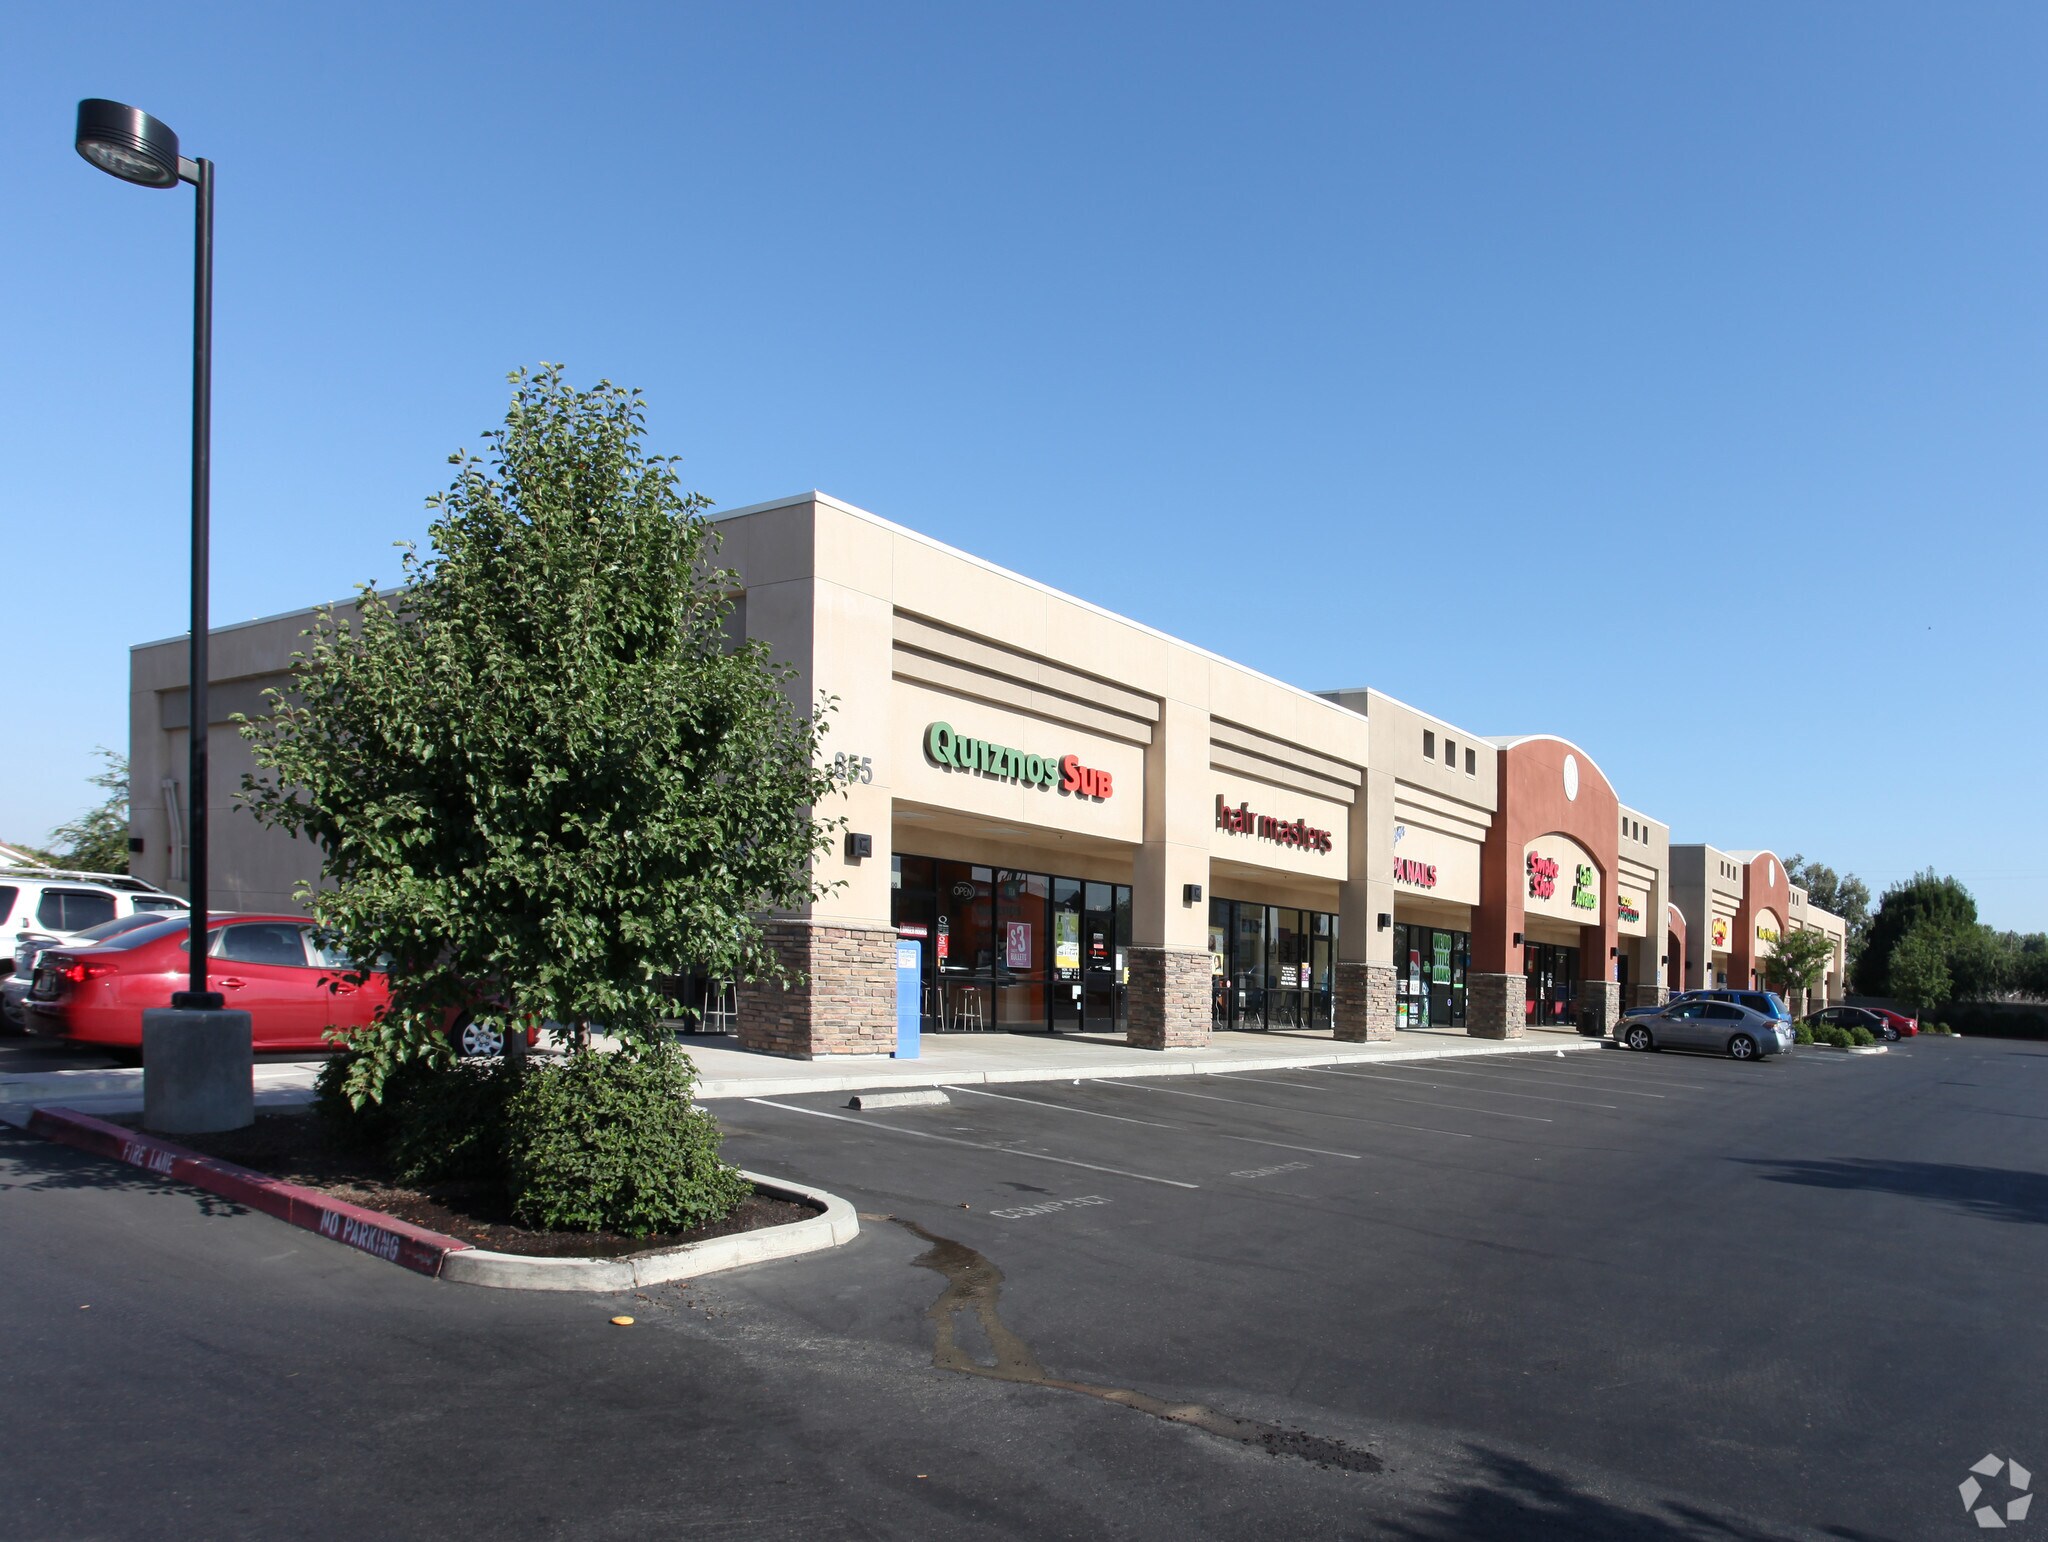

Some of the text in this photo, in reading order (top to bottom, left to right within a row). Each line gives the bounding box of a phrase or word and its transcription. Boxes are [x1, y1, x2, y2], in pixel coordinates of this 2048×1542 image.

[834, 751, 873, 785] 855
[1217, 796, 1333, 853] hair masters
[1406, 859, 1438, 888] NAILS
[1528, 850, 1560, 879] Smoke
[953, 886, 973, 898] OPEN
[1530, 874, 1556, 900] Shop
[122, 1141, 177, 1175] FIRE LANE
[989, 1194, 1114, 1219] COMPACT
[320, 1209, 401, 1262] NO PARKING
